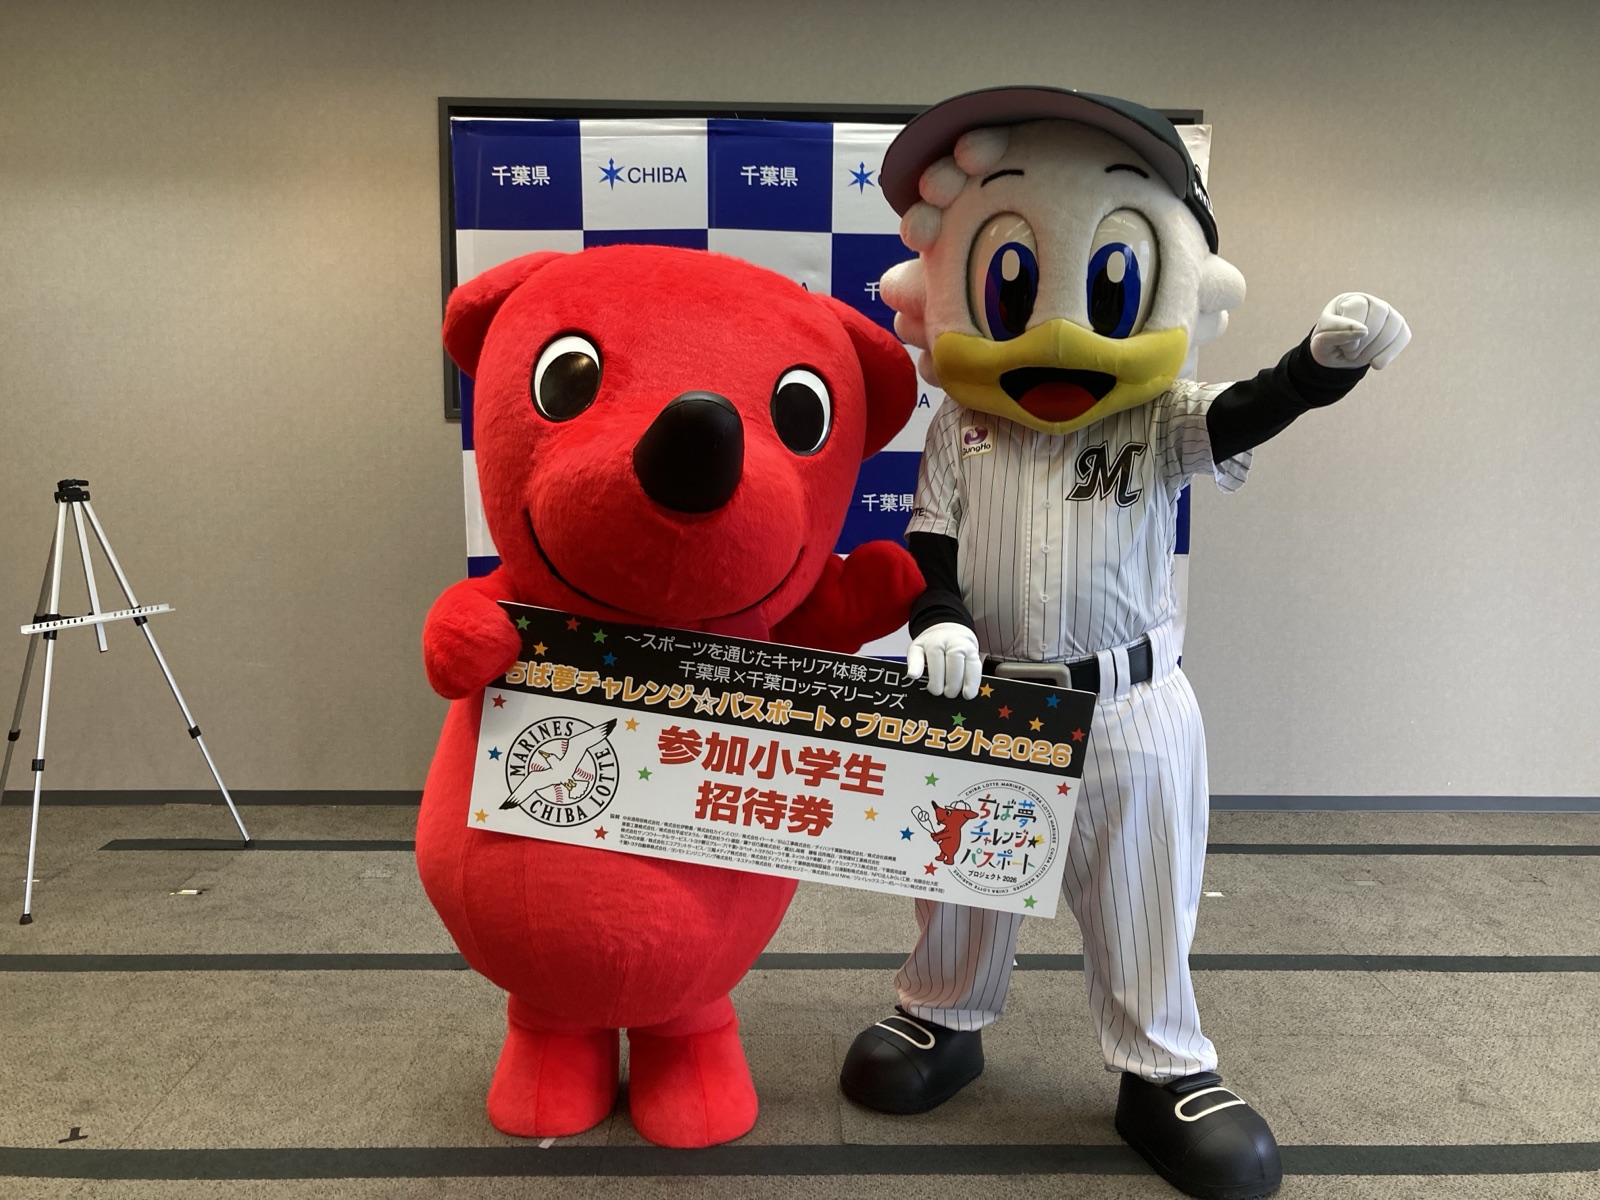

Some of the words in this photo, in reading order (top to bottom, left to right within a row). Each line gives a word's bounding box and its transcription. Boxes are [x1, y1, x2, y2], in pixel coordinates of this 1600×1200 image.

[491, 165, 550, 186] 千葉県
[627, 167, 688, 184] CHIBA
[740, 165, 798, 187] 千葉県
[1065, 440, 1148, 508] M
[861, 493, 914, 512] 千葉県
[510, 720, 574, 777] MARINES
[654, 723, 889, 798] 参加小学生
[530, 800, 588, 823] CHIBA
[589, 748, 615, 808] LOTTE
[965, 786, 981, 796] CHIBA
[1000, 782, 1025, 792] MARINES
[693, 778, 835, 838] 招待券
[978, 794, 1036, 828] ちば夢
[960, 848, 1036, 874] パスポート
